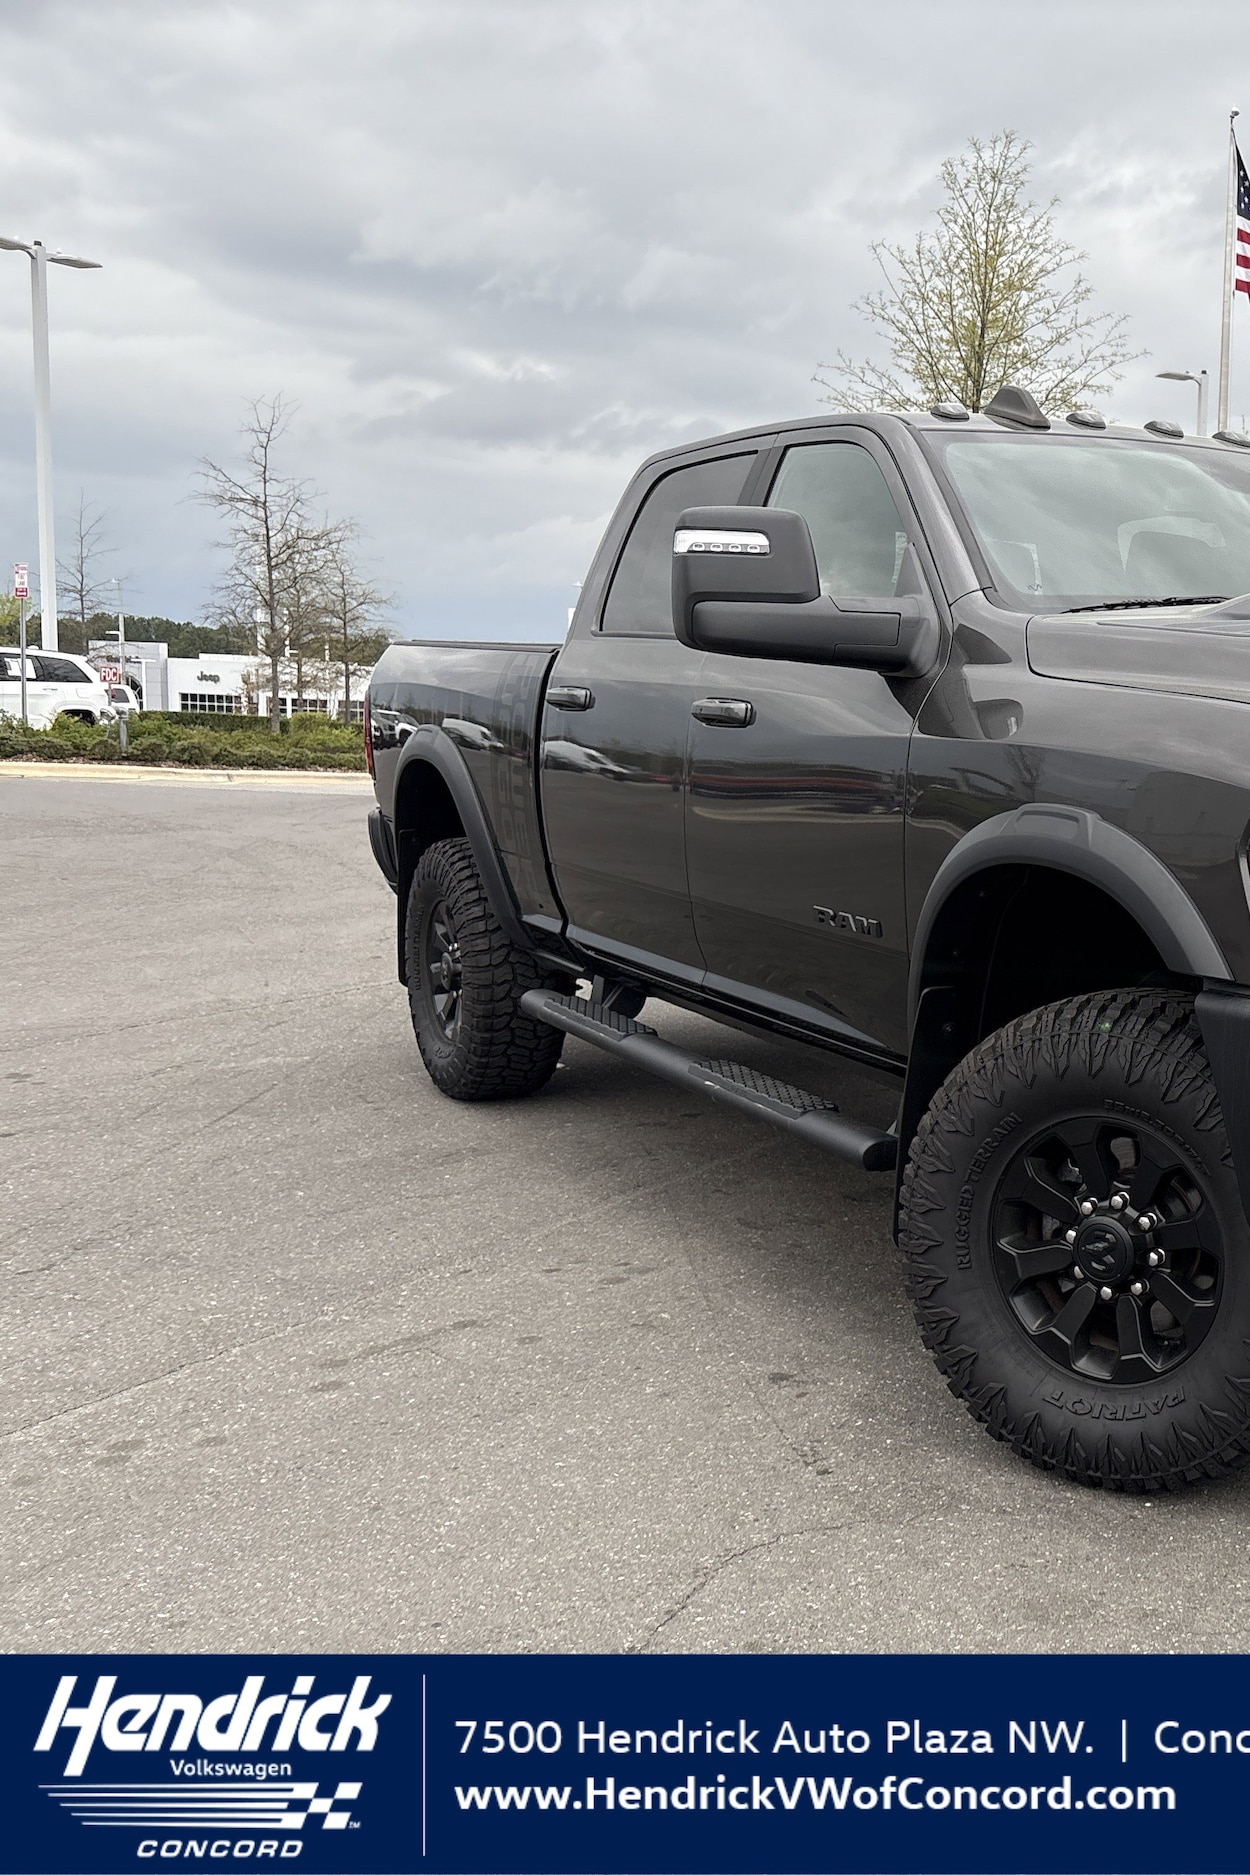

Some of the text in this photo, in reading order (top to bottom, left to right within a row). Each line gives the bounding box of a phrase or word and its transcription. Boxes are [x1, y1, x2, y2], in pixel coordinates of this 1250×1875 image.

[101, 667, 117, 681] FDC
[197, 671, 220, 684] Jeep
[813, 905, 883, 938] RAM
[954, 1111, 1025, 1271] RUGGED TERRAIN
[1042, 1385, 1187, 1422] PATRIOT
